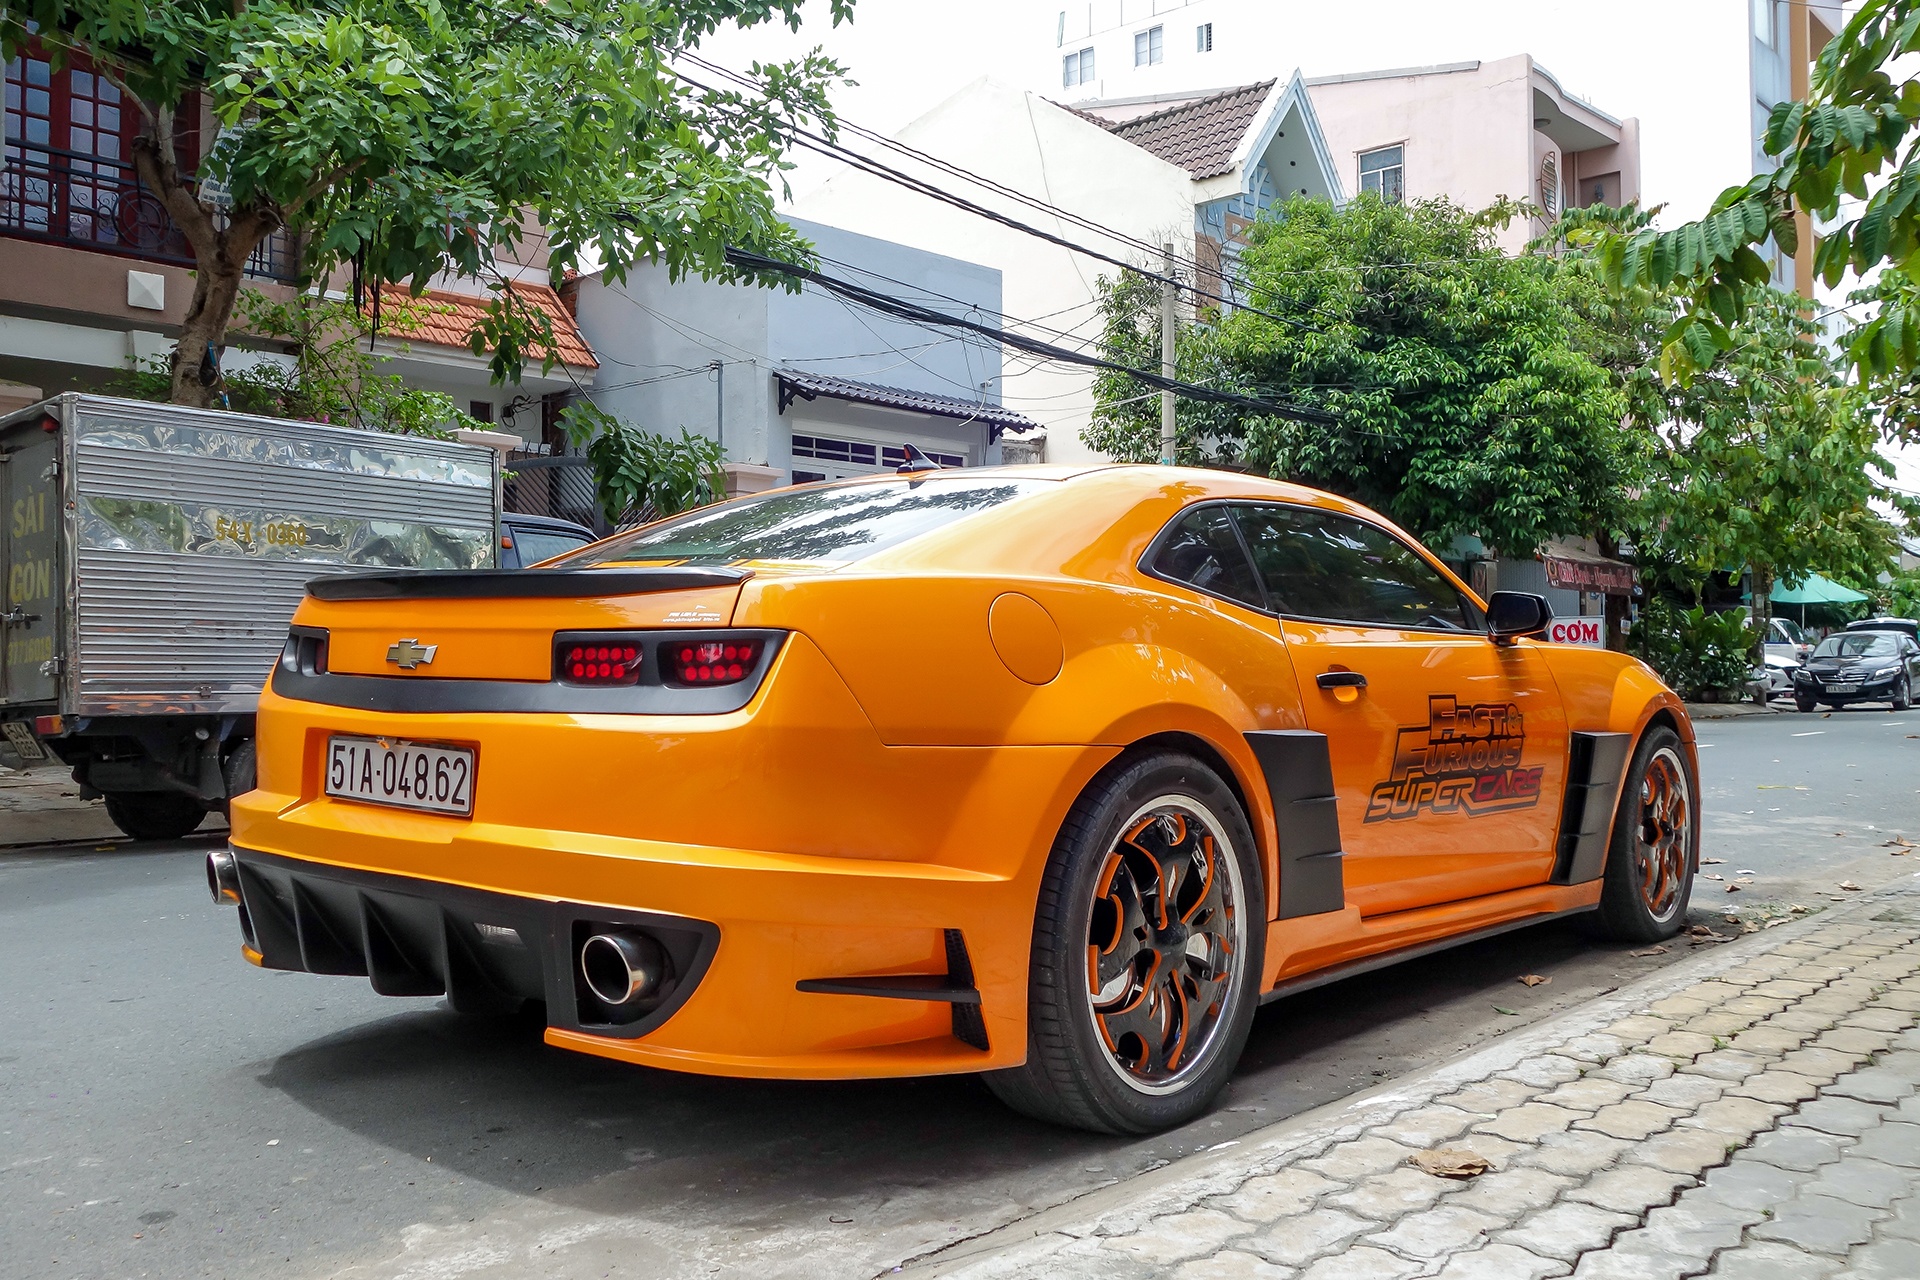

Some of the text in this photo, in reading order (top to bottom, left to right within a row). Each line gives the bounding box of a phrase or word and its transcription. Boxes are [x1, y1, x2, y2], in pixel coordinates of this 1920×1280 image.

[13, 485, 45, 539] SÀI
[10, 550, 50, 604] GÒN
[1552, 620, 1599, 643] CƠM
[1428, 695, 1507, 740] FAST
[1391, 730, 1523, 782] FURIOUS
